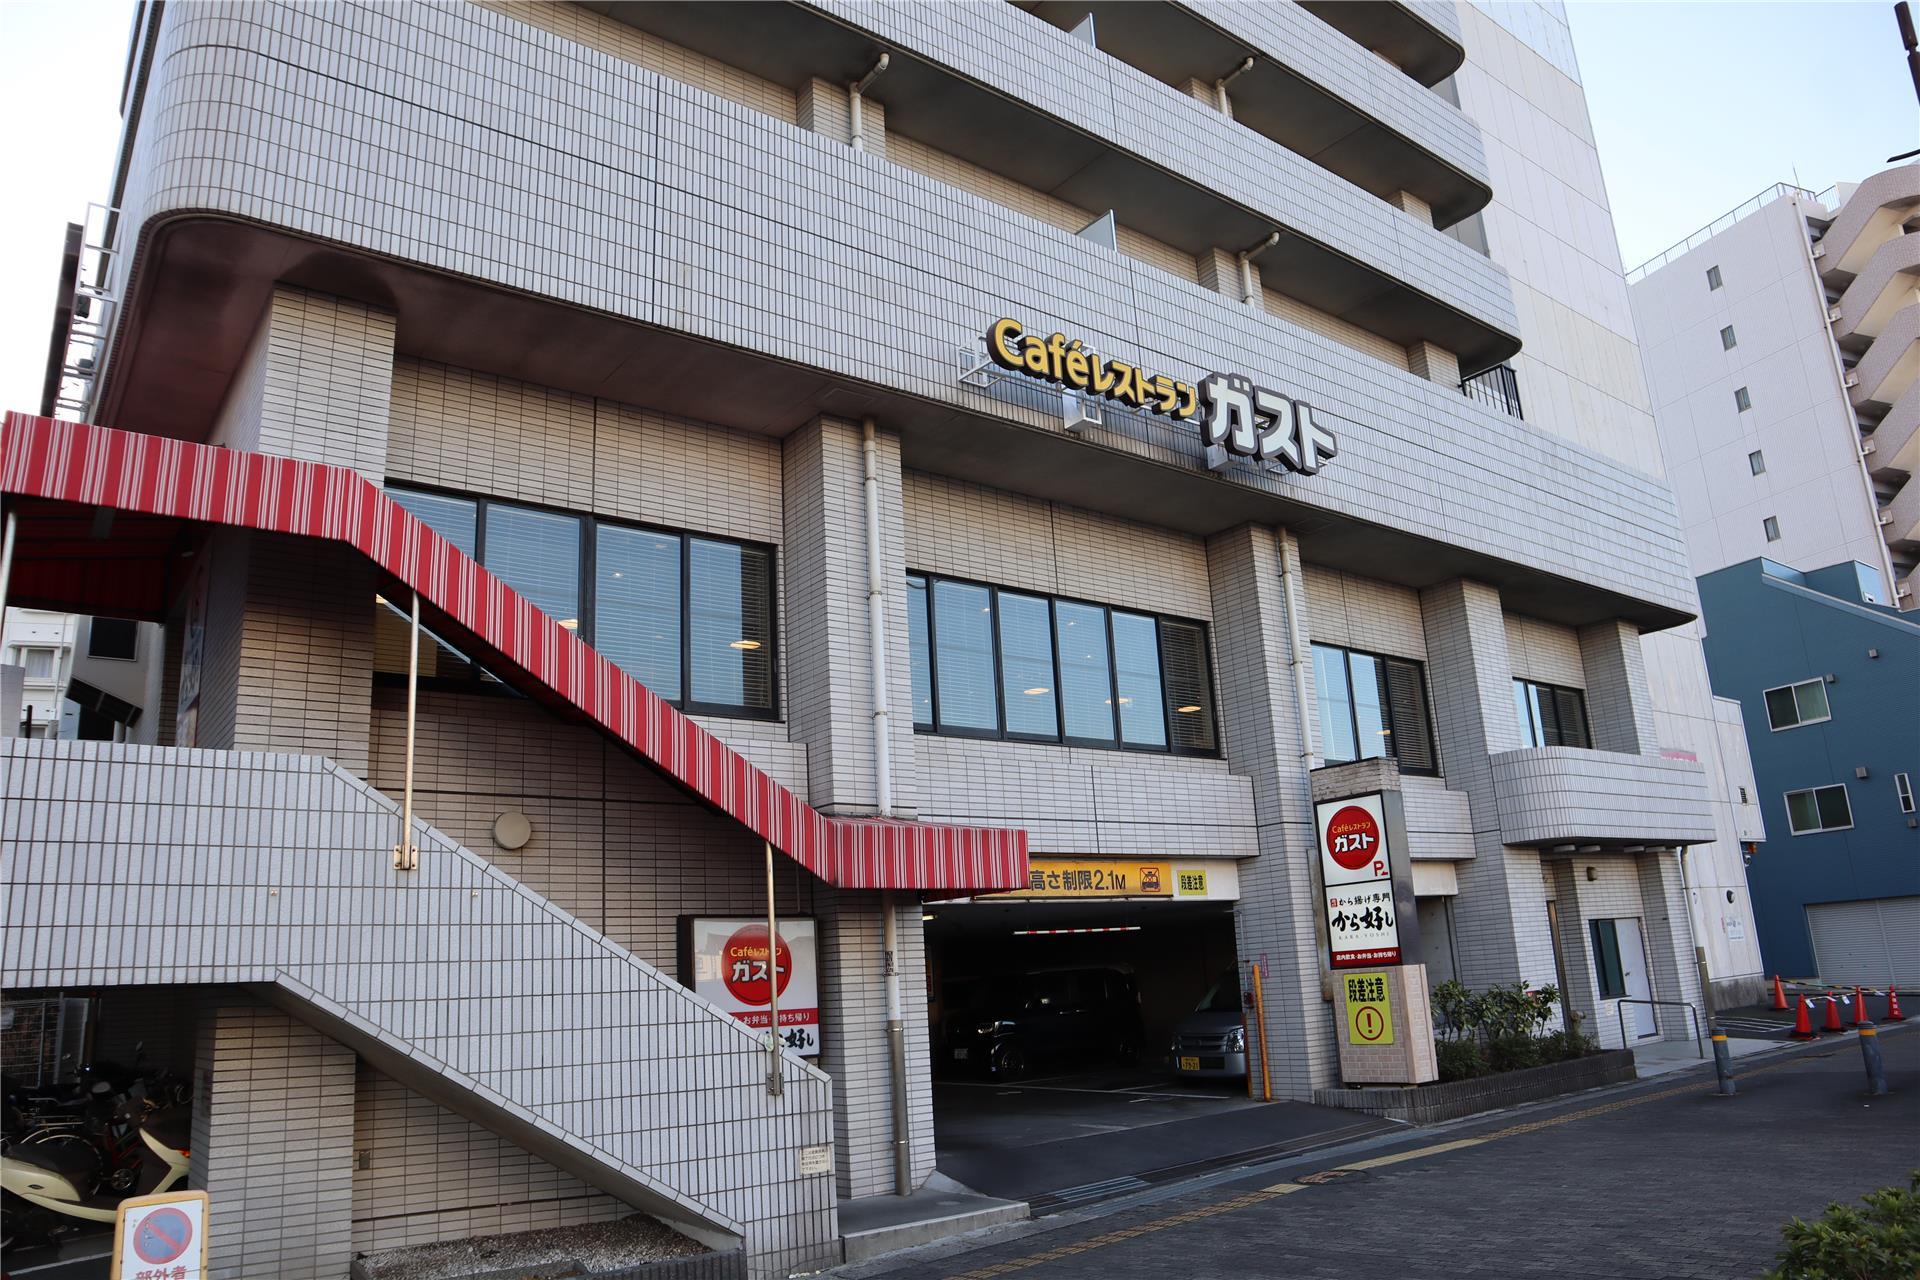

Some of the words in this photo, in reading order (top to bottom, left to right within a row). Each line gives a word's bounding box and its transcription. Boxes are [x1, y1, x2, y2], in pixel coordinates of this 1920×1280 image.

[1205, 373, 1336, 474] ガスト
[1335, 833, 1374, 853] ガスト
[1373, 861, 1385, 877] P
[1332, 906, 1393, 932] から好し
[1348, 977, 1386, 1003] 段差注意
